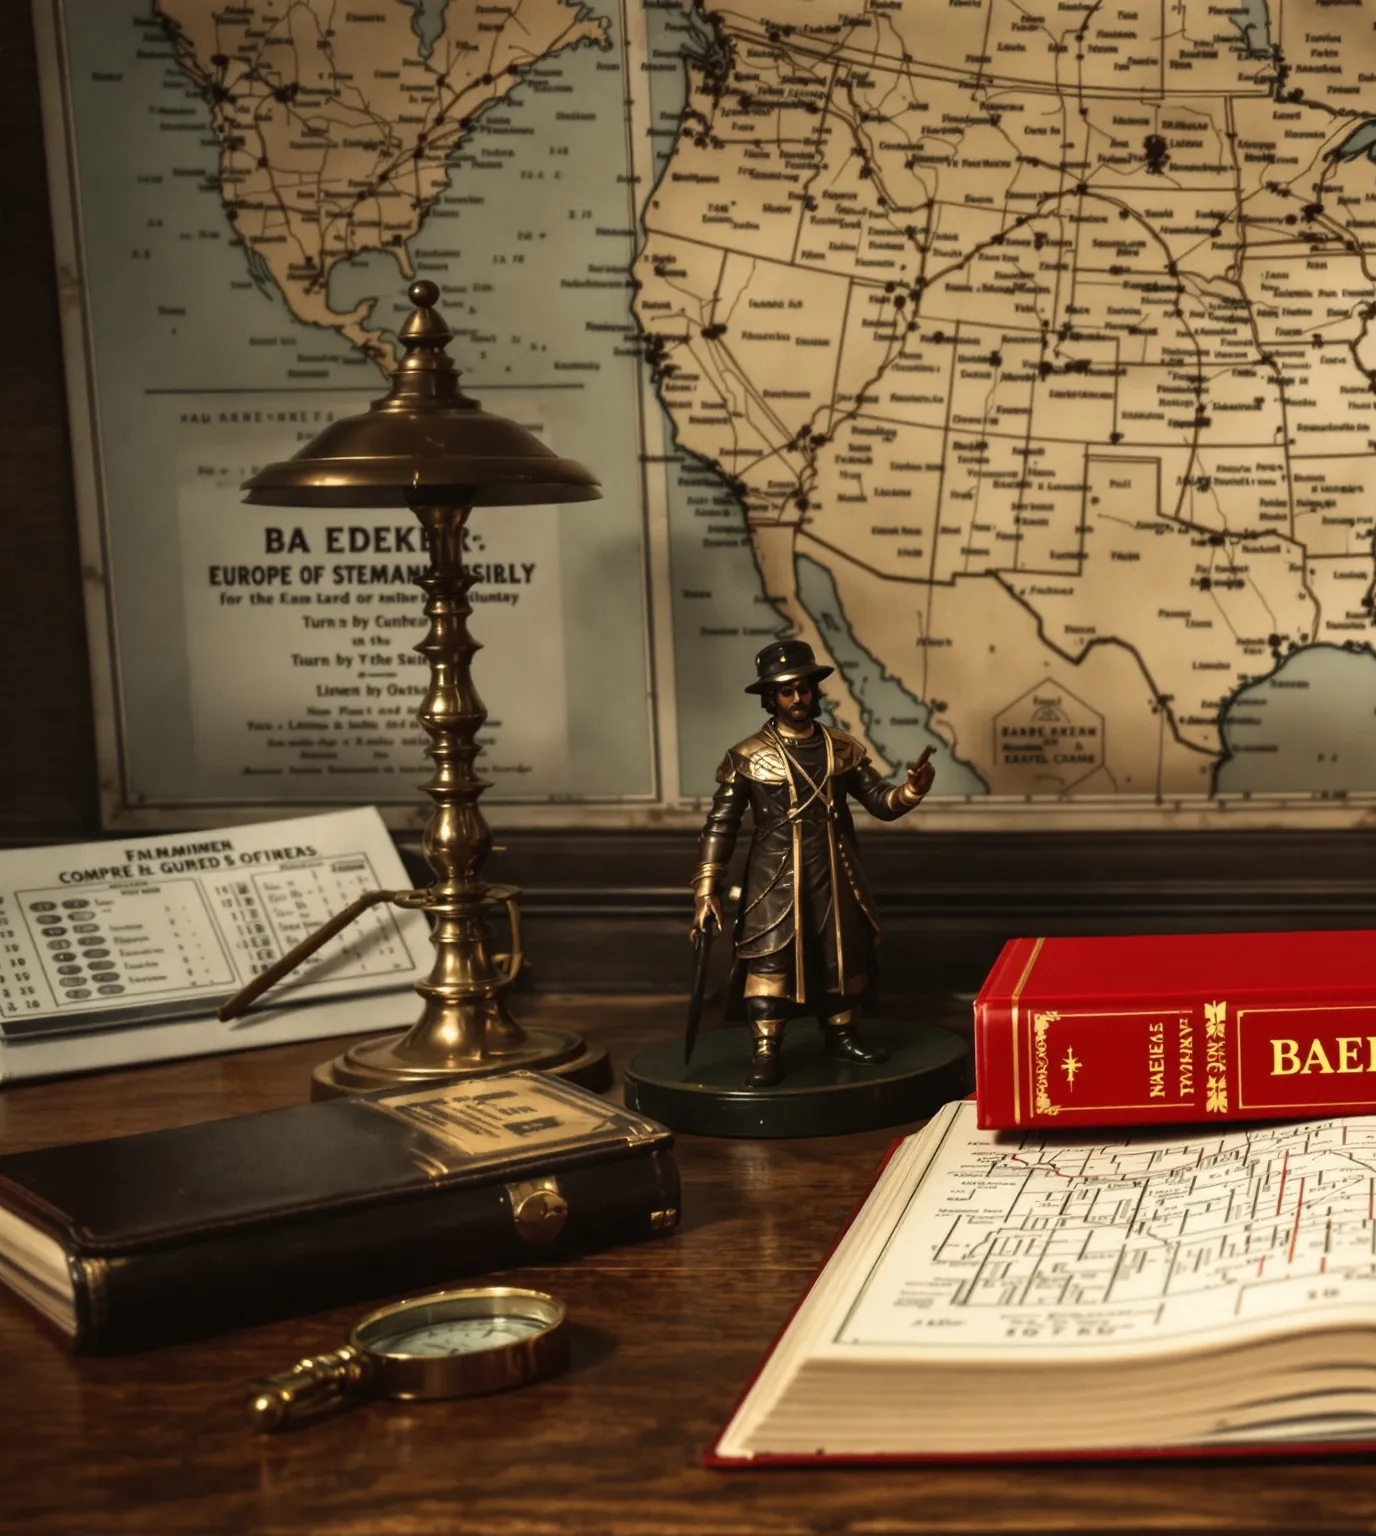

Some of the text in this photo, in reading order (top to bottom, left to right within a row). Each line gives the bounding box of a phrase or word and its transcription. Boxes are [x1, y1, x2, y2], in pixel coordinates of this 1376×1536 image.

[264, 526, 311, 553] BA
[208, 565, 292, 587] EUROPE
[299, 565, 325, 586] OF
[249, 593, 274, 605] the
[352, 615, 369, 631] by
[335, 653, 353, 669] by
